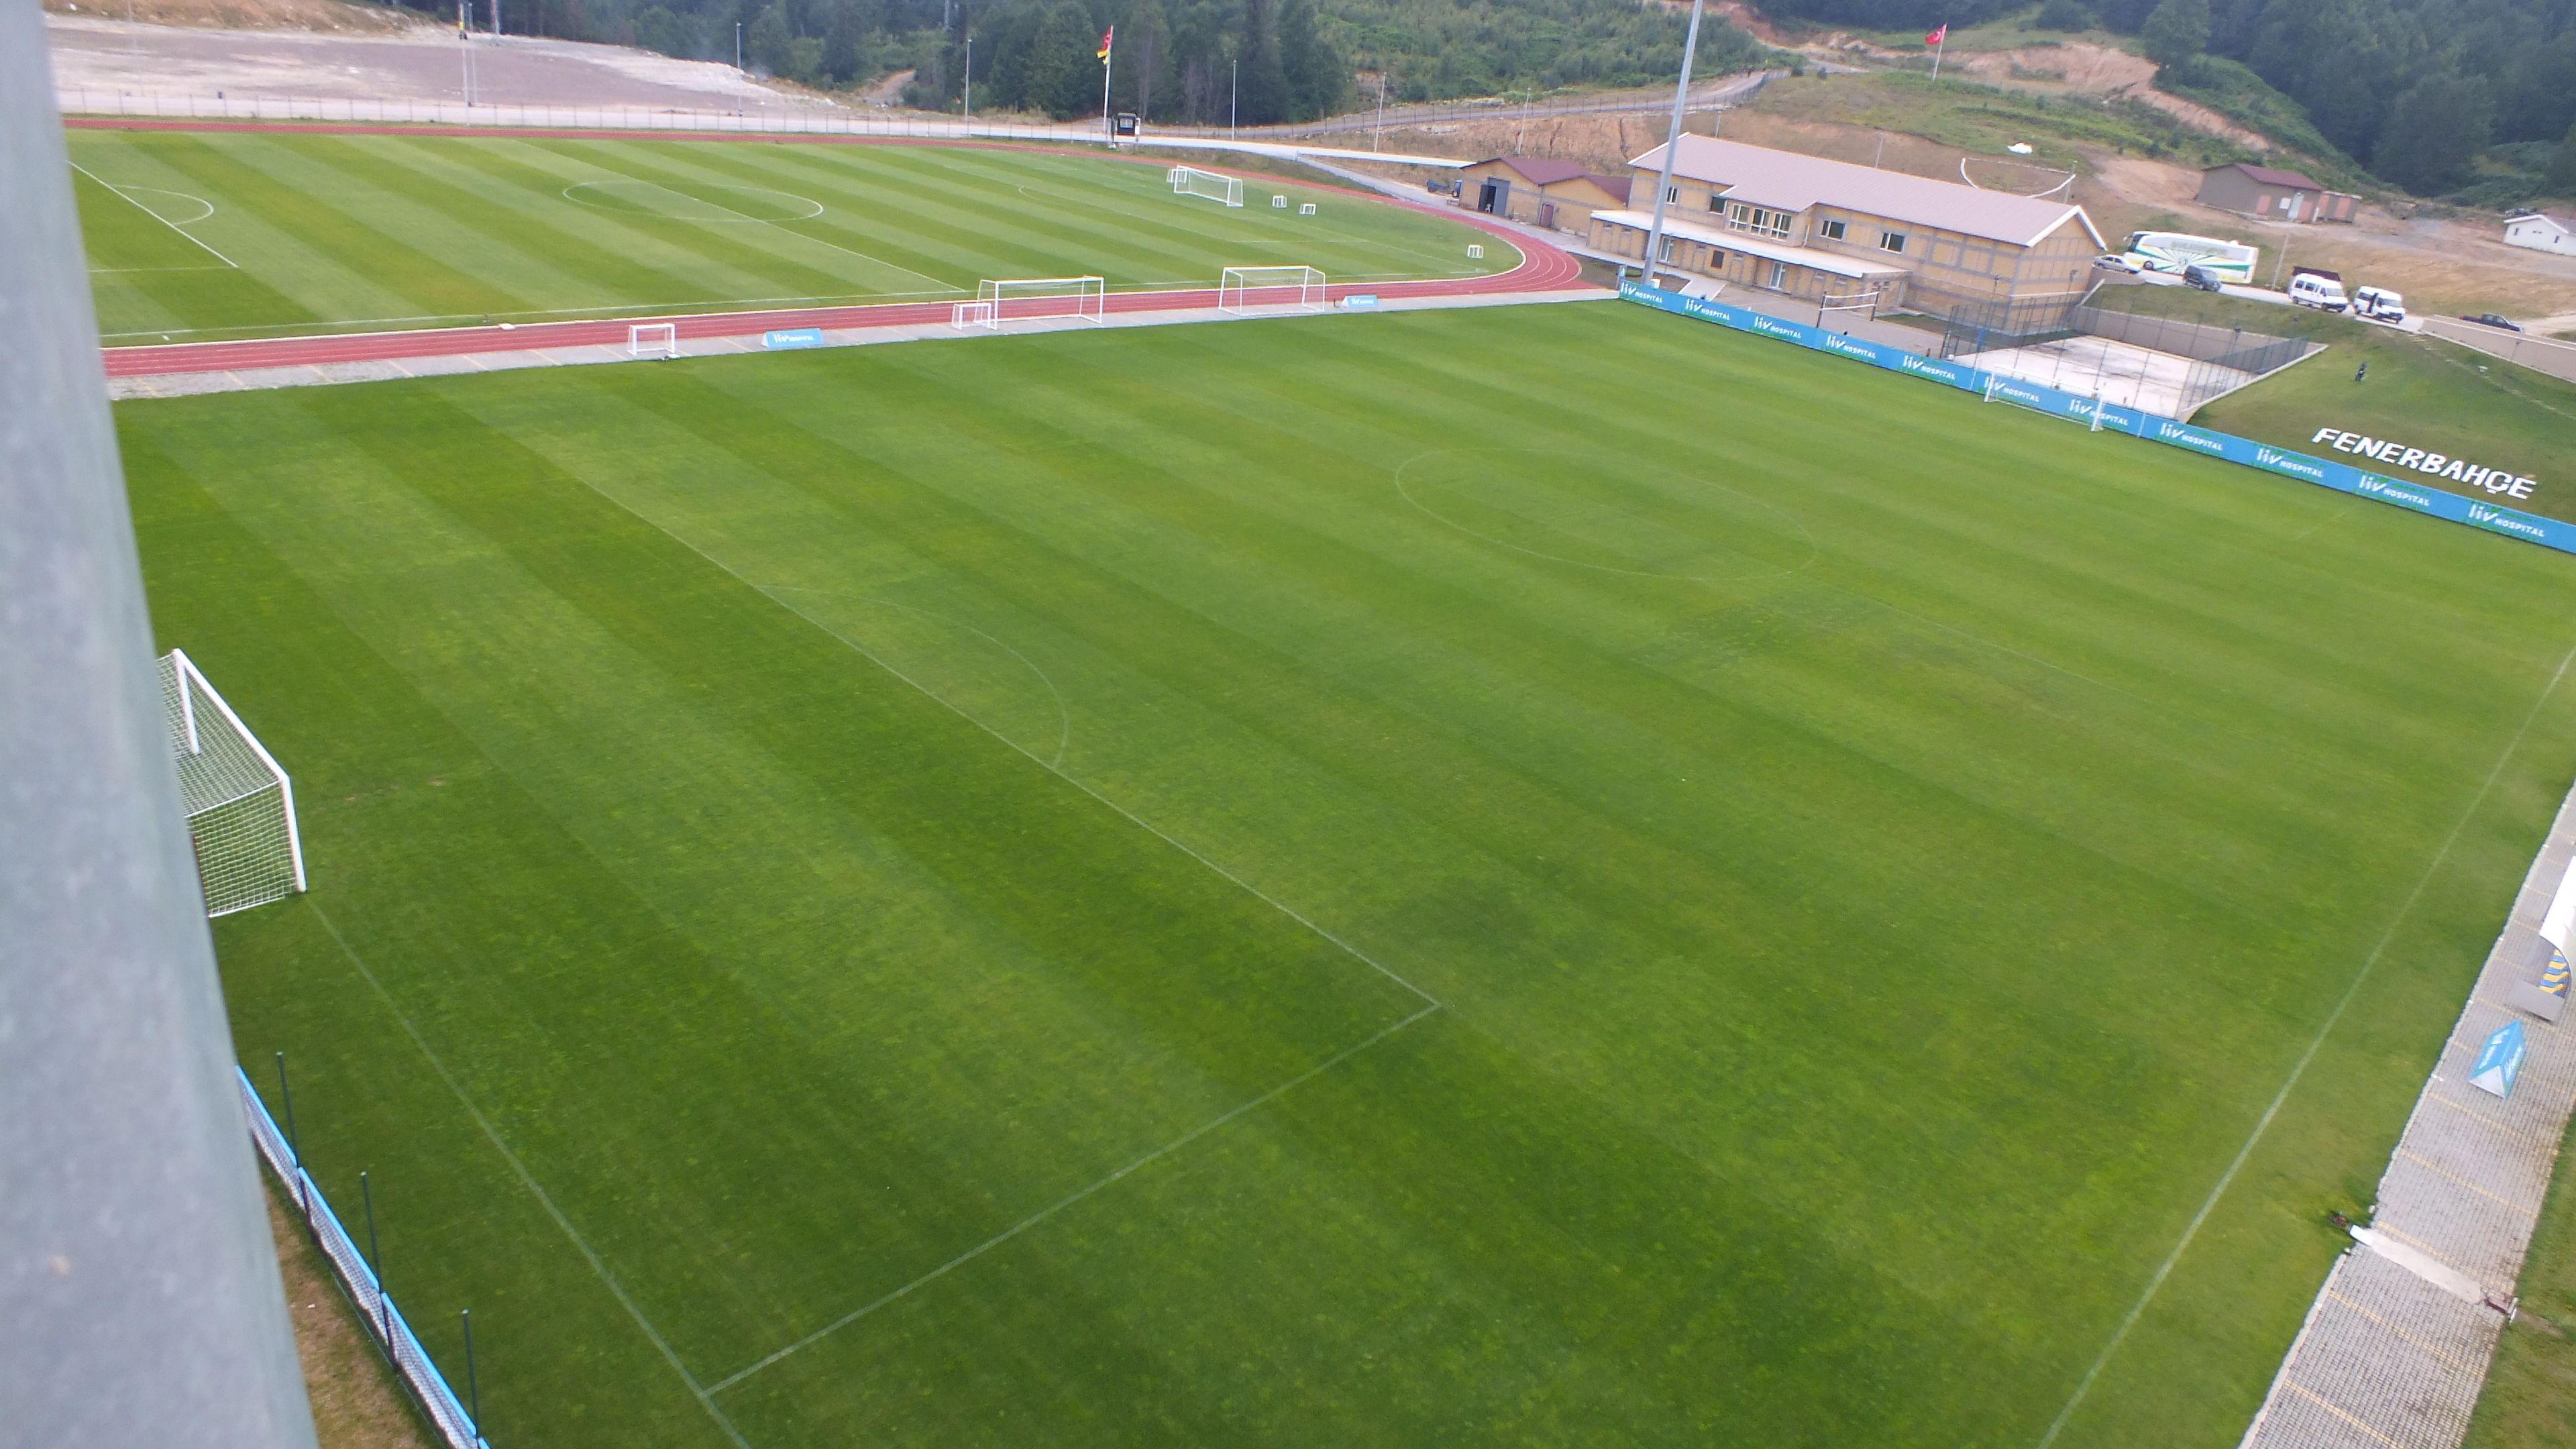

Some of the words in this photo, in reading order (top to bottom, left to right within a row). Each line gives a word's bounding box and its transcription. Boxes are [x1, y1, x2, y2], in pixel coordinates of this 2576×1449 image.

[1621, 282, 1637, 295] liv
[1635, 291, 1663, 303] HOSPITAL
[1685, 298, 1703, 312] liv
[1701, 309, 1731, 321] HOSPITAL
[1754, 316, 1773, 330] liv
[1770, 325, 1802, 339] HOSPITAL
[1826, 335, 1845, 349] liv
[1843, 345, 1876, 359] HOSPITAL
[1902, 355, 1923, 370] liv
[1921, 366, 1956, 380] HOSPITAL
[1984, 376, 2006, 390] lv
[2069, 398, 2092, 414] liv
[2159, 423, 2185, 439] liv
[2182, 435, 2222, 451] HOSPITAL
[2256, 448, 2284, 464] liv
[2279, 462, 2324, 478] HOSPITAL
[2311, 427, 2537, 499] FENERBAHÇE
[2358, 474, 2387, 492] liv
[2383, 489, 2430, 506] HOSPITAL
[2468, 504, 2498, 521] liv
[2494, 517, 2544, 537] HOSPITAL
